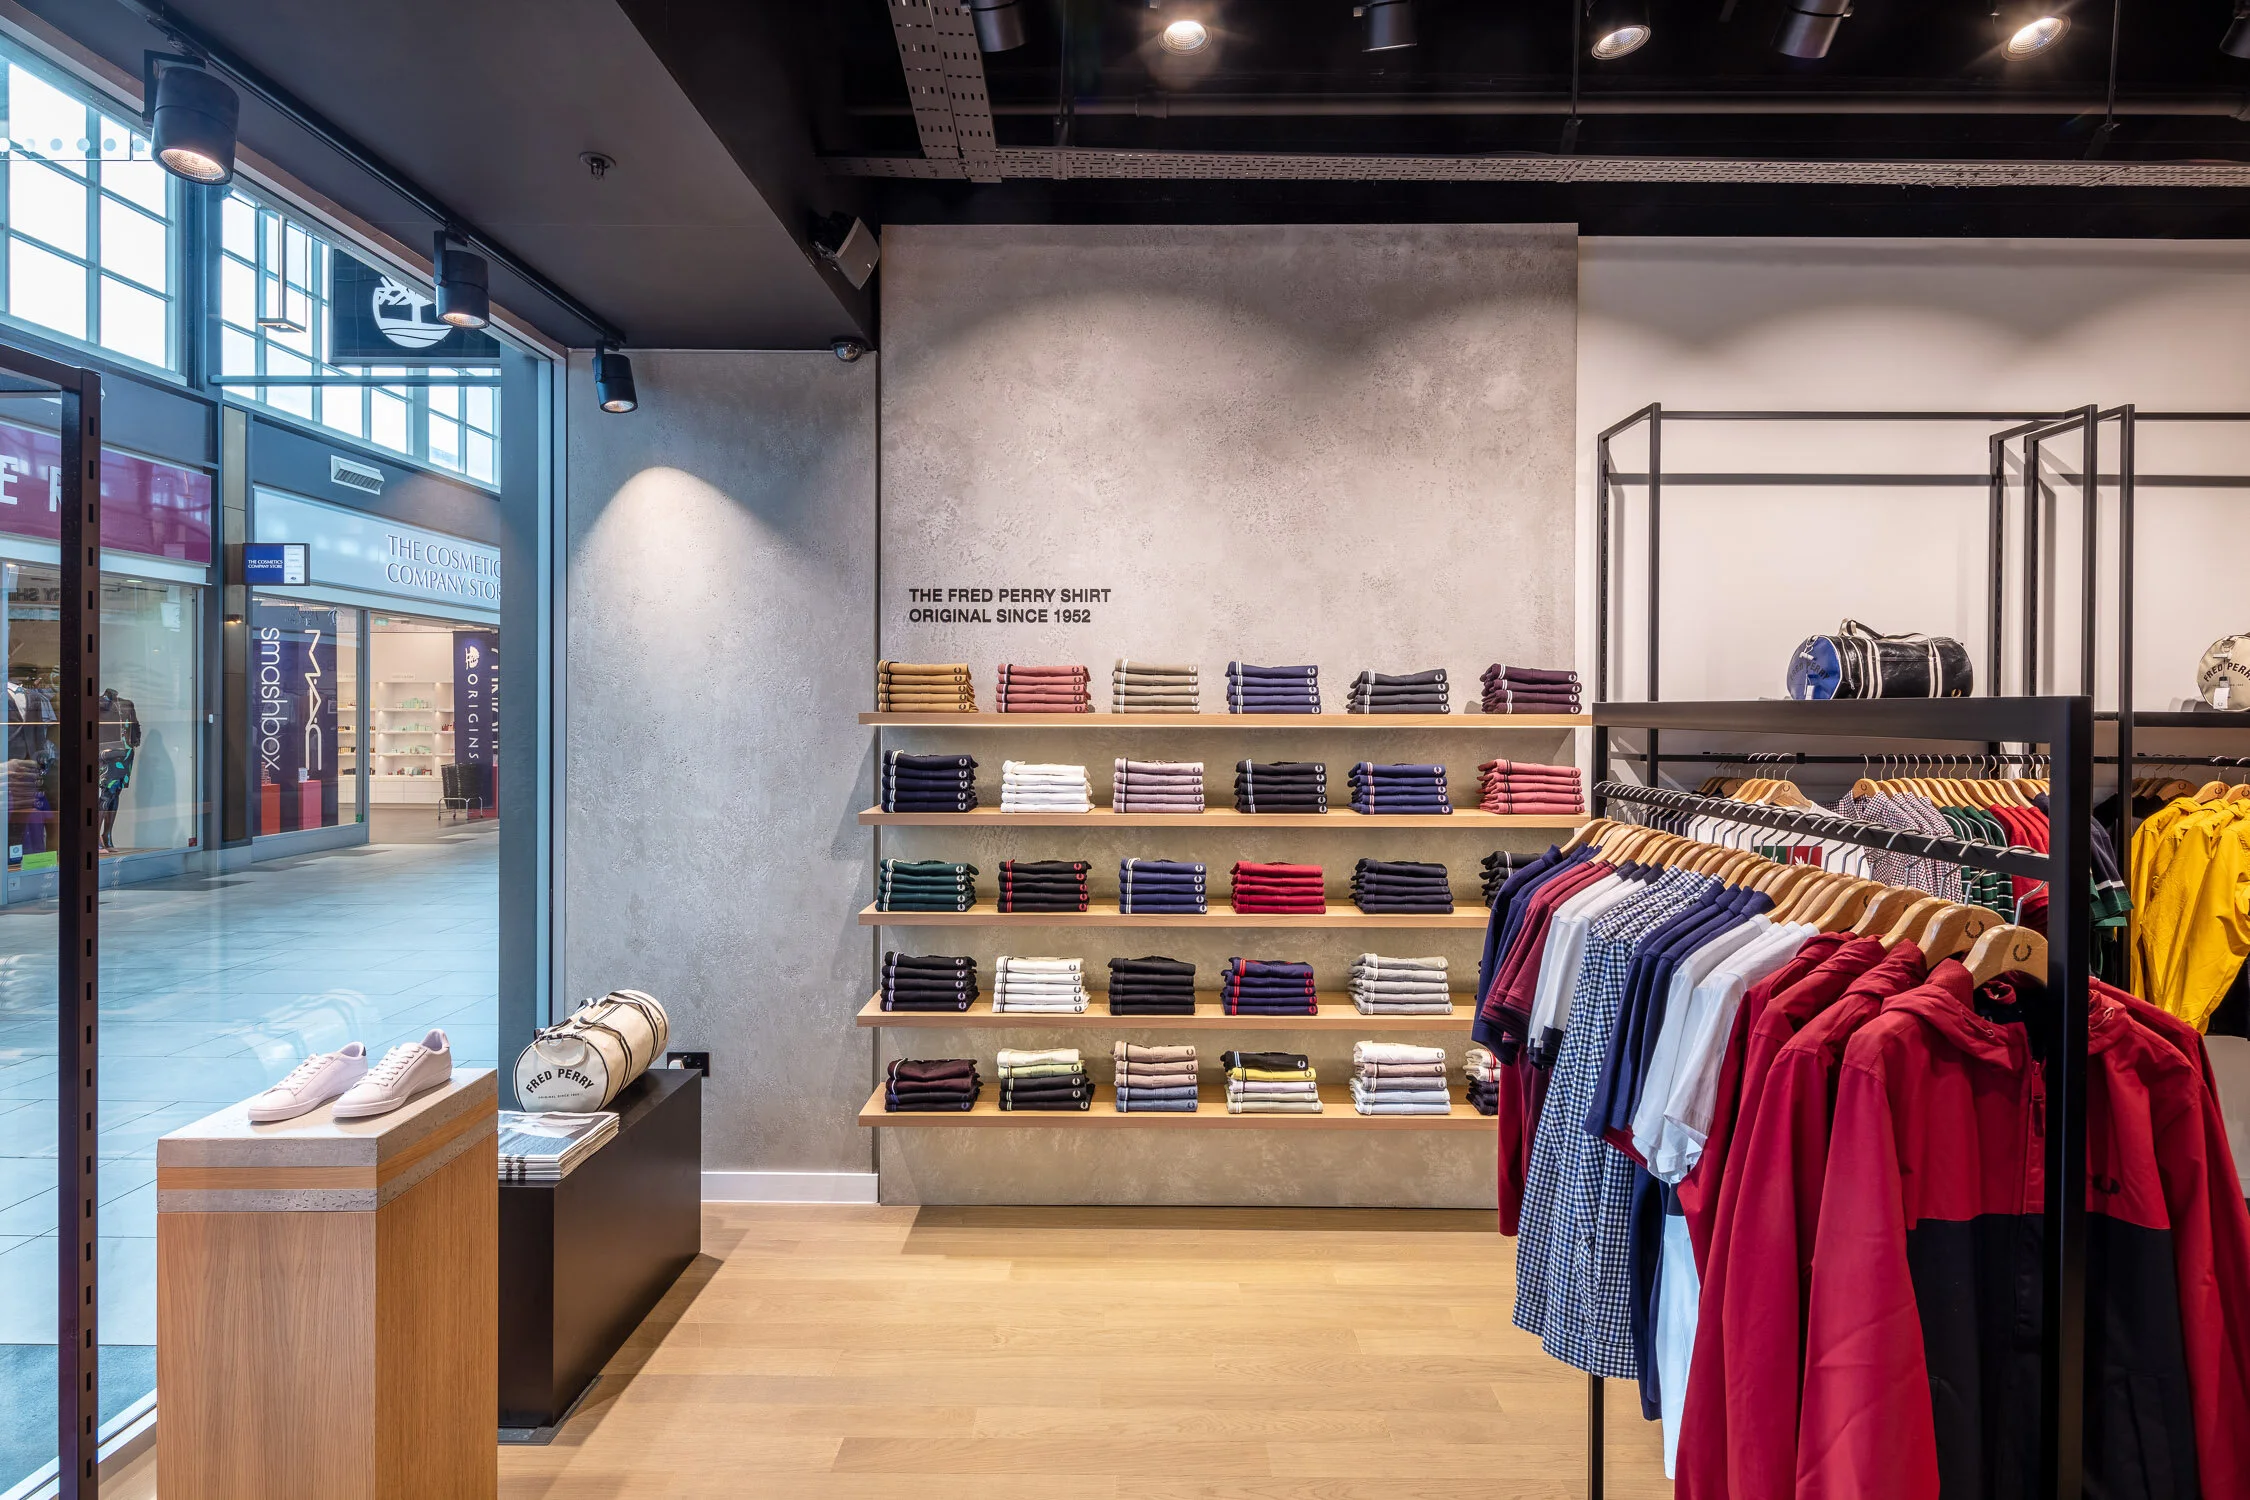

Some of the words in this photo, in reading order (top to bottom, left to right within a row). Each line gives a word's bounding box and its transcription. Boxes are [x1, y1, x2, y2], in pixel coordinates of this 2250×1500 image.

[386, 534, 420, 561] THE
[386, 562, 466, 594] COMPANY
[909, 588, 943, 603] THE
[949, 588, 993, 603] FRED
[999, 588, 1056, 603] PERRY
[1060, 588, 1112, 603] SHIRT
[909, 608, 991, 623] ORIGINAL
[996, 608, 1048, 623] SINCE
[1054, 608, 1091, 623] 1952
[1806, 660, 1830, 680] PERRY
[2203, 663, 2223, 682] FRED
[260, 627, 288, 771] smashbox
[467, 673, 479, 759] ORIGINS
[525, 1070, 552, 1093] FRED
[557, 1068, 594, 1090] PERRY
